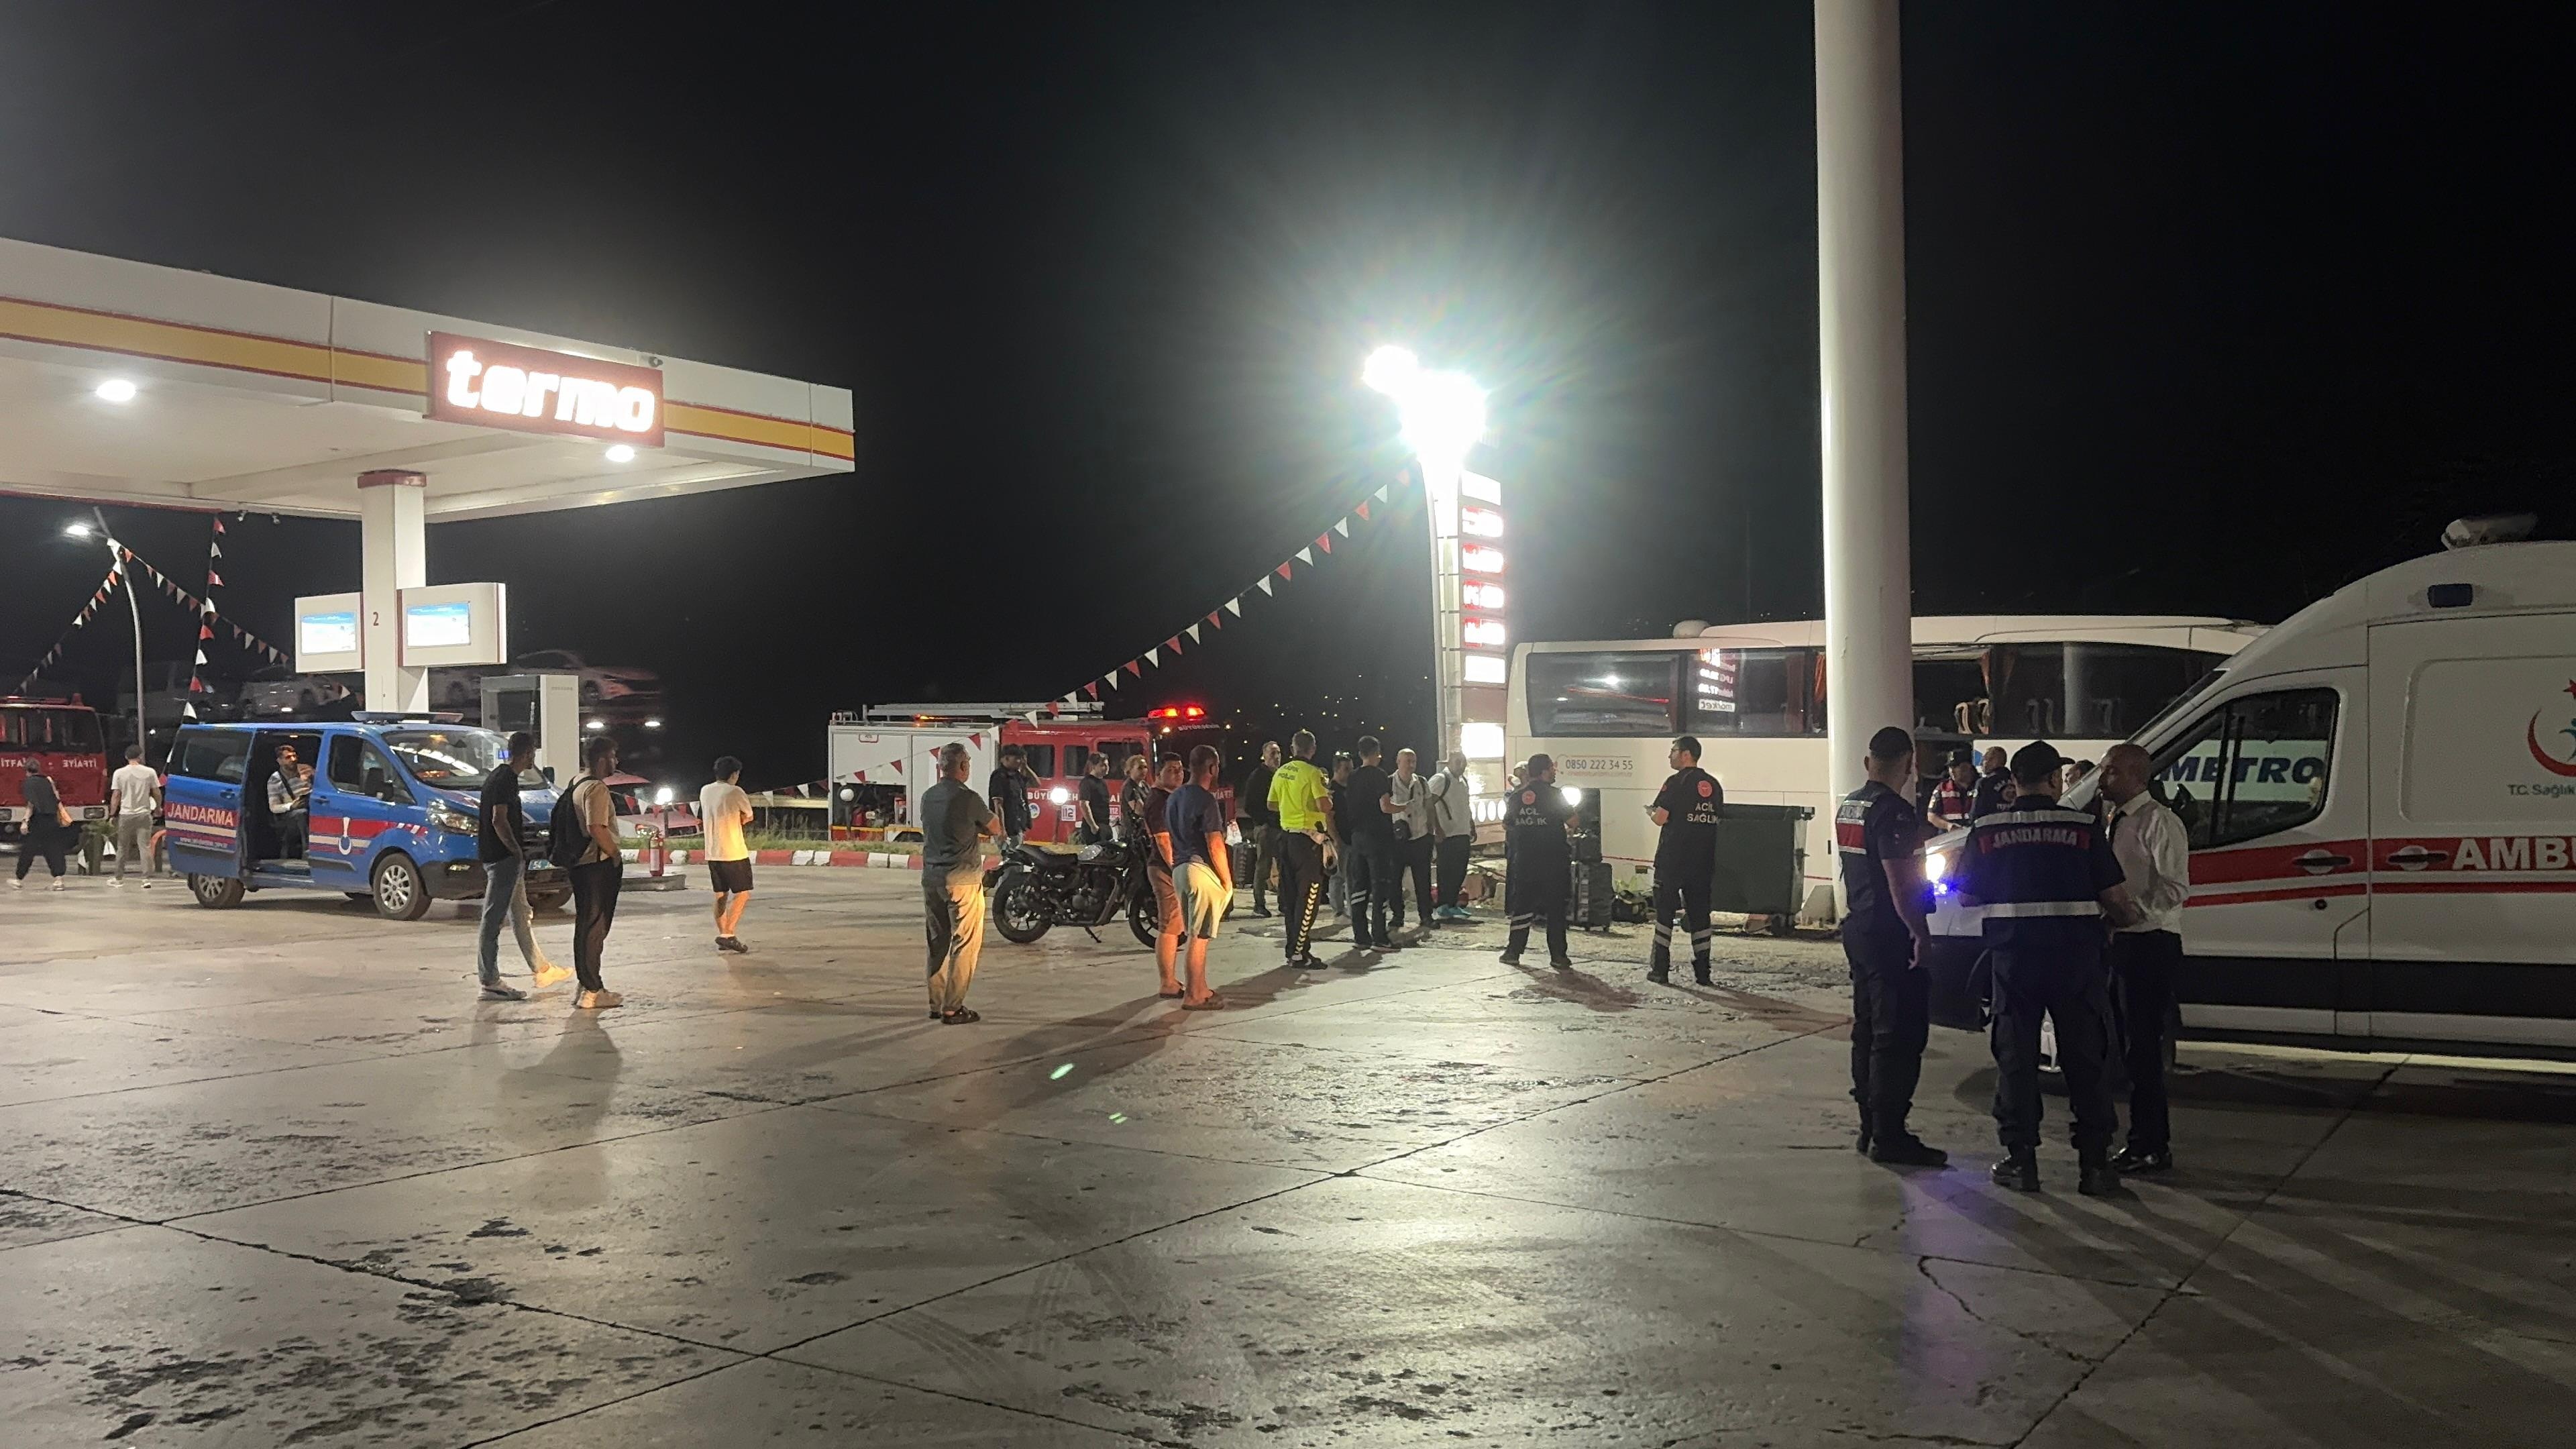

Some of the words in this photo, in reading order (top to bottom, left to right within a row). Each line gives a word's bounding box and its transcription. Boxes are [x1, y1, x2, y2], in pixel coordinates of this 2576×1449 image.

[447, 351, 655, 432] termo
[373, 612, 379, 626] 2
[1566, 759, 1587, 769] 0850
[1590, 759, 1606, 769] 222
[1609, 759, 1620, 770] 34
[1623, 760, 1633, 770] 55
[168, 803, 233, 826] JANDARMA
[1063, 808, 1074, 817] 112
[1992, 827, 2078, 848] JANDARMA
[2452, 838, 2576, 870] AMB
